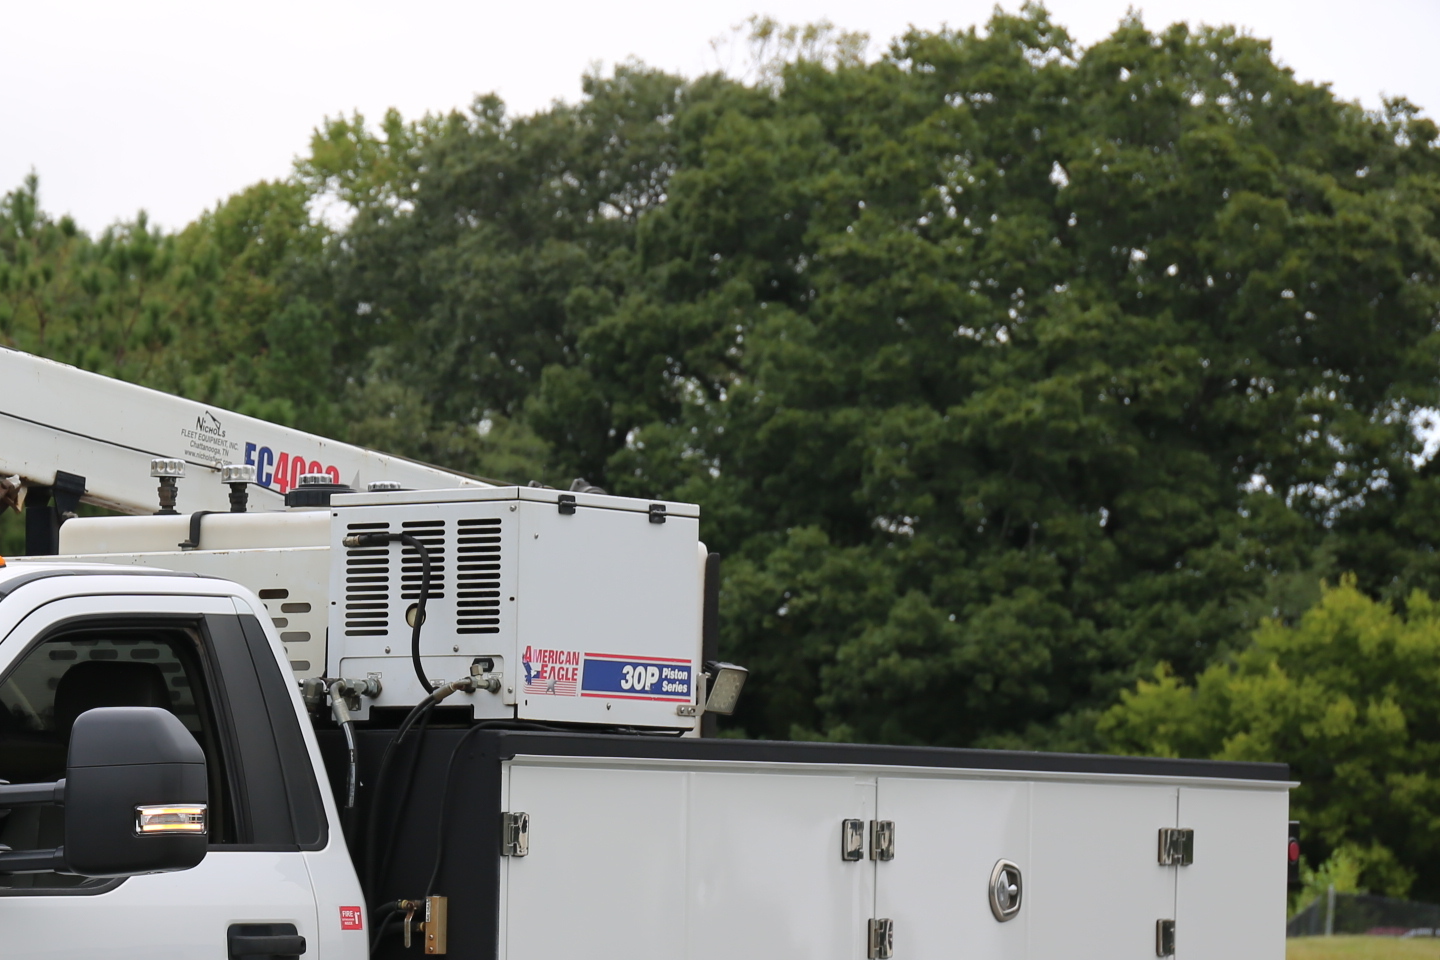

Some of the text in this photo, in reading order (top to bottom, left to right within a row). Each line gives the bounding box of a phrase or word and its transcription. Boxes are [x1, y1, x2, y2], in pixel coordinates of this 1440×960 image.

[181, 428, 239, 450] FLEET EQUIPMENT, INC.
[190, 440, 229, 456] Chattanooga, TN
[524, 645, 580, 665] AMERICAN
[540, 663, 578, 681] EAGLE
[620, 664, 688, 691] 30P Piston
[662, 680, 688, 693] Series
